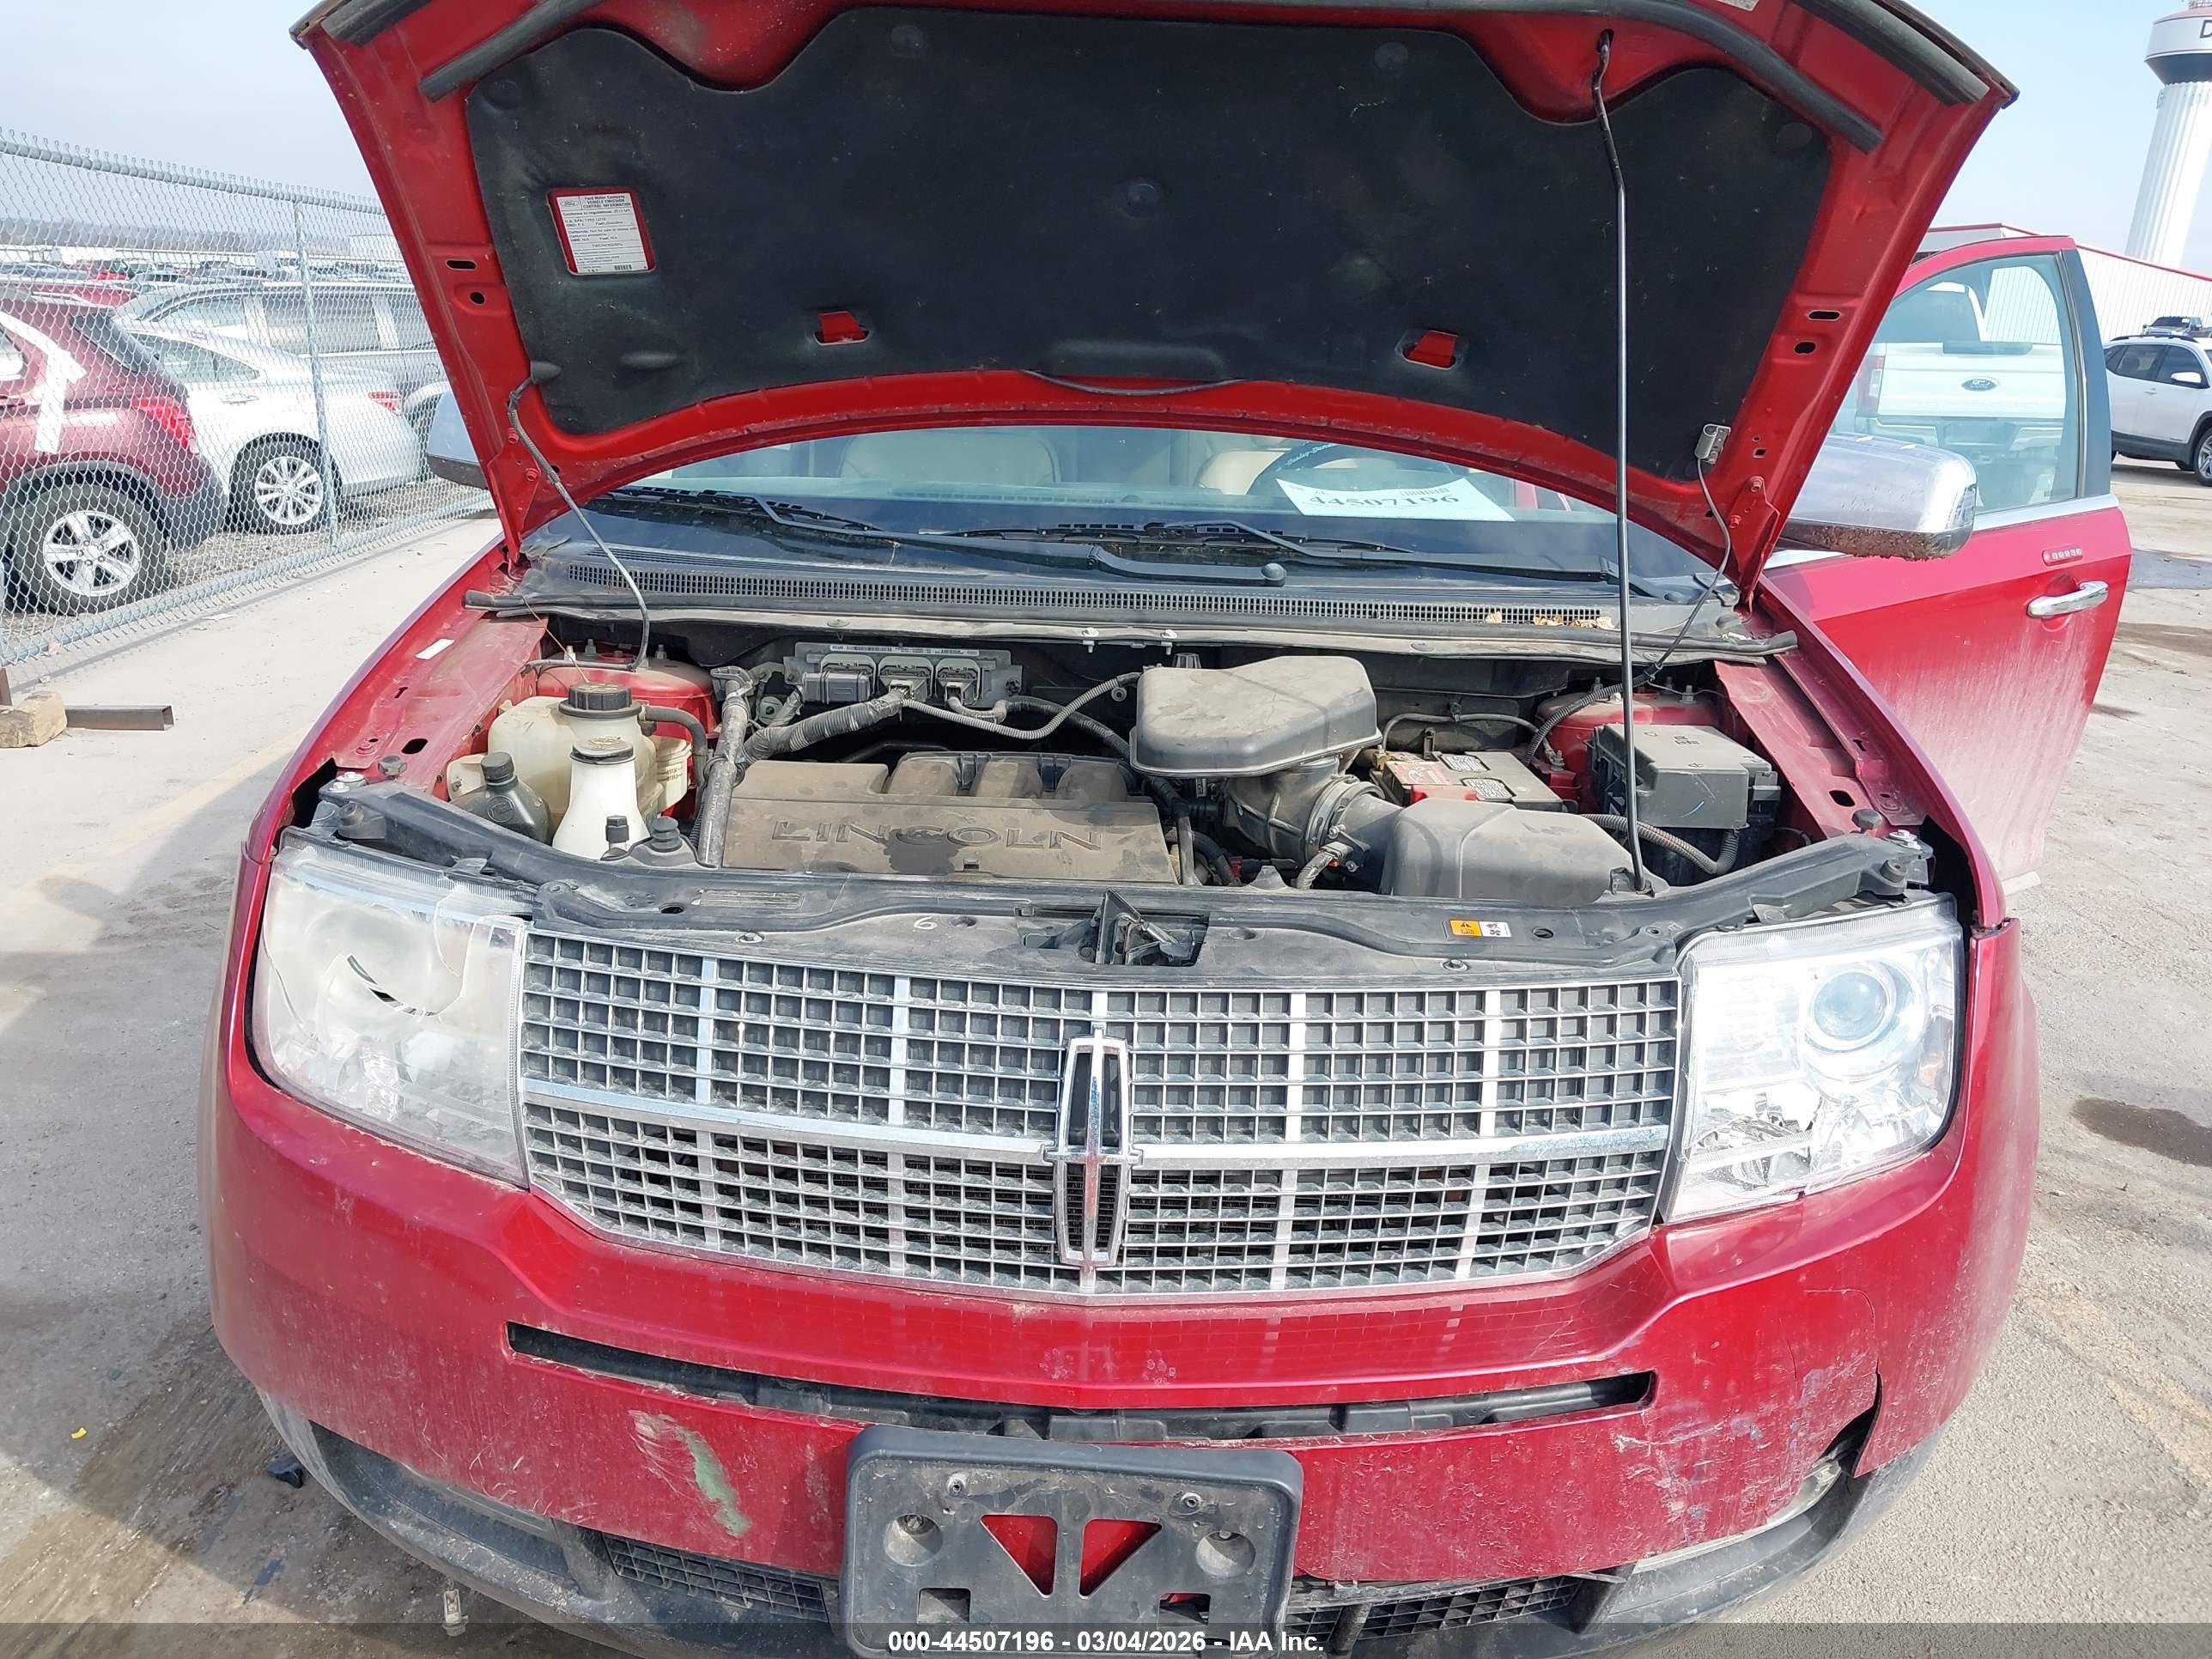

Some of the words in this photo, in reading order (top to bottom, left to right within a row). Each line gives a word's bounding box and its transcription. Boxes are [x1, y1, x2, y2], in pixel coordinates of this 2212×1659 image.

[1310, 495, 1460, 506] 44507196
[771, 820, 1104, 852] LINCOLN
[914, 916, 938, 930] 6
